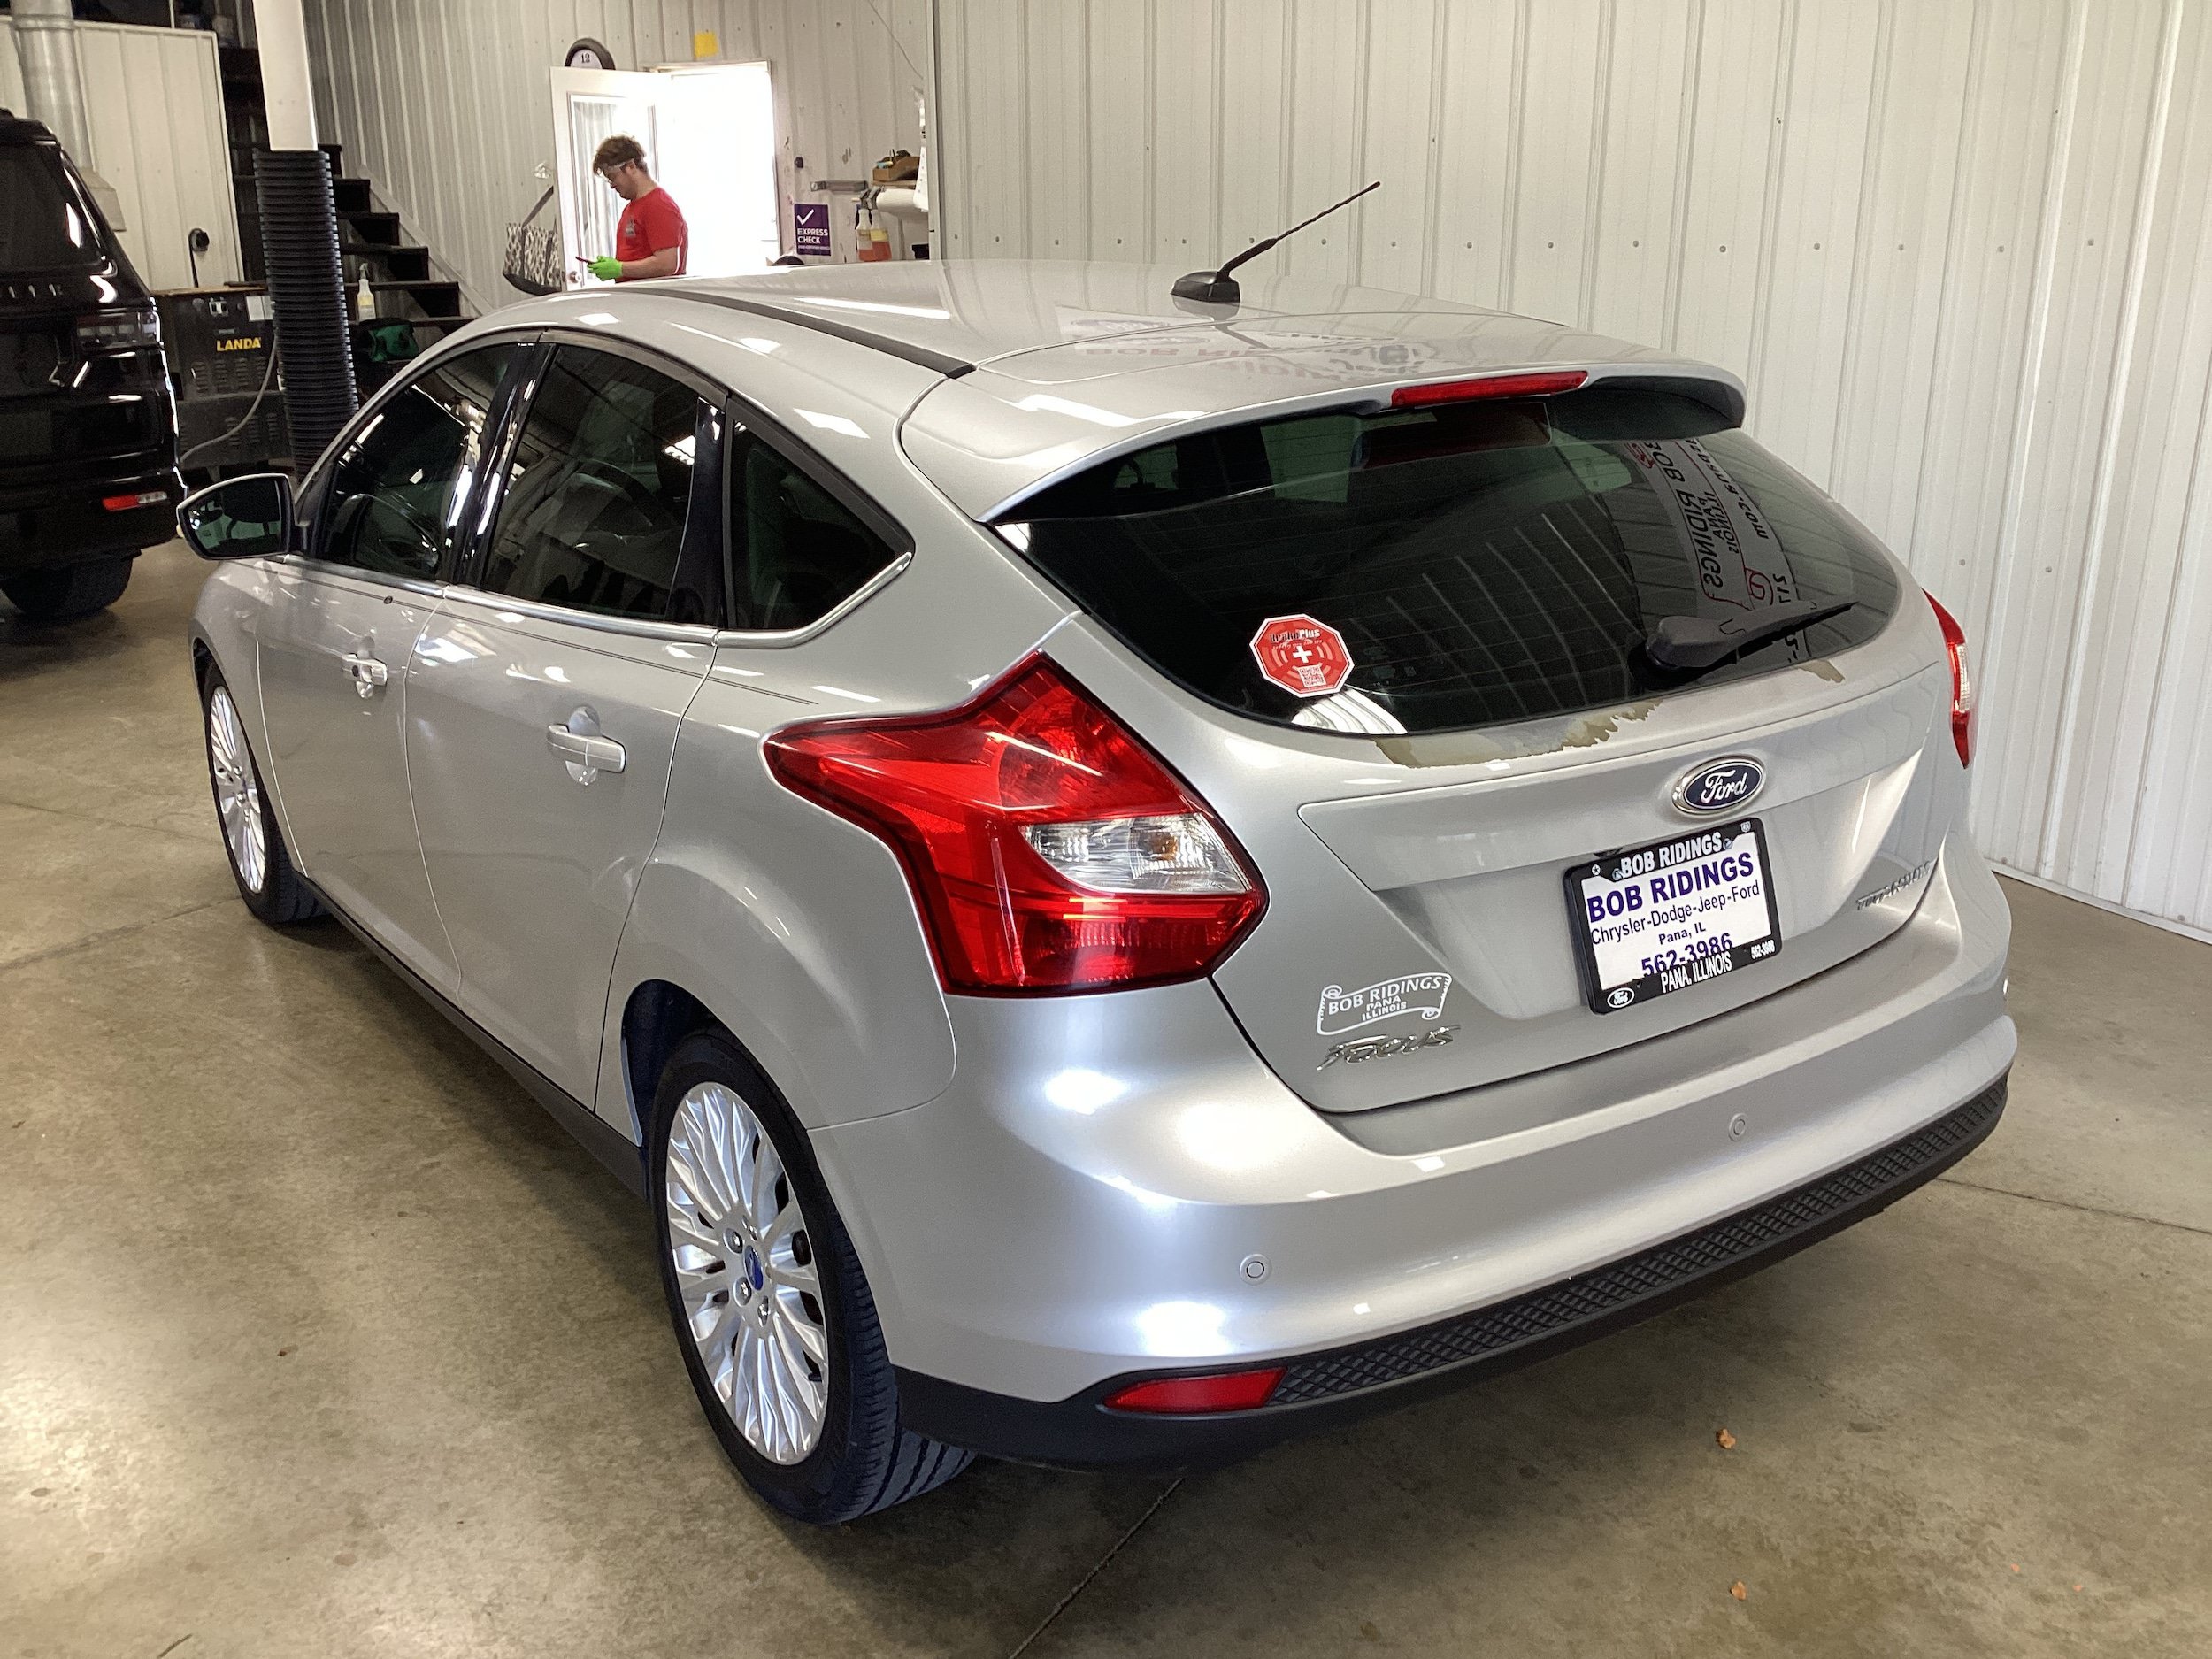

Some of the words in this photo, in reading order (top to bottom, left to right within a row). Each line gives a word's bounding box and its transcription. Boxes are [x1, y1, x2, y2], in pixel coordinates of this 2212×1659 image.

[580, 53, 590, 64] 12
[797, 227, 829, 236] EXPRESS
[797, 235, 821, 244] CHECK
[216, 336, 262, 352] LANDA
[1701, 769, 1748, 804] Ford
[1620, 851, 1655, 879] BOB
[1659, 832, 1723, 868] RIDINGS
[1587, 885, 1643, 924] BOB
[1650, 852, 1754, 905] RIDINGS
[1591, 879, 1761, 945] Chrysler-Dodge-Jeep-Ford
[1659, 929, 1692, 946] Pana,
[1694, 922, 1707, 934] IL
[1641, 933, 1734, 977] 562-3986
[1661, 964, 1692, 994] PANA,
[1692, 952, 1732, 984] ILLINOIS
[1328, 994, 1364, 1015] BOB
[1369, 976, 1443, 1003] RIDINGS
[1366, 995, 1402, 1011] PANA
[1362, 1002, 1408, 1021] ILLINOIS
